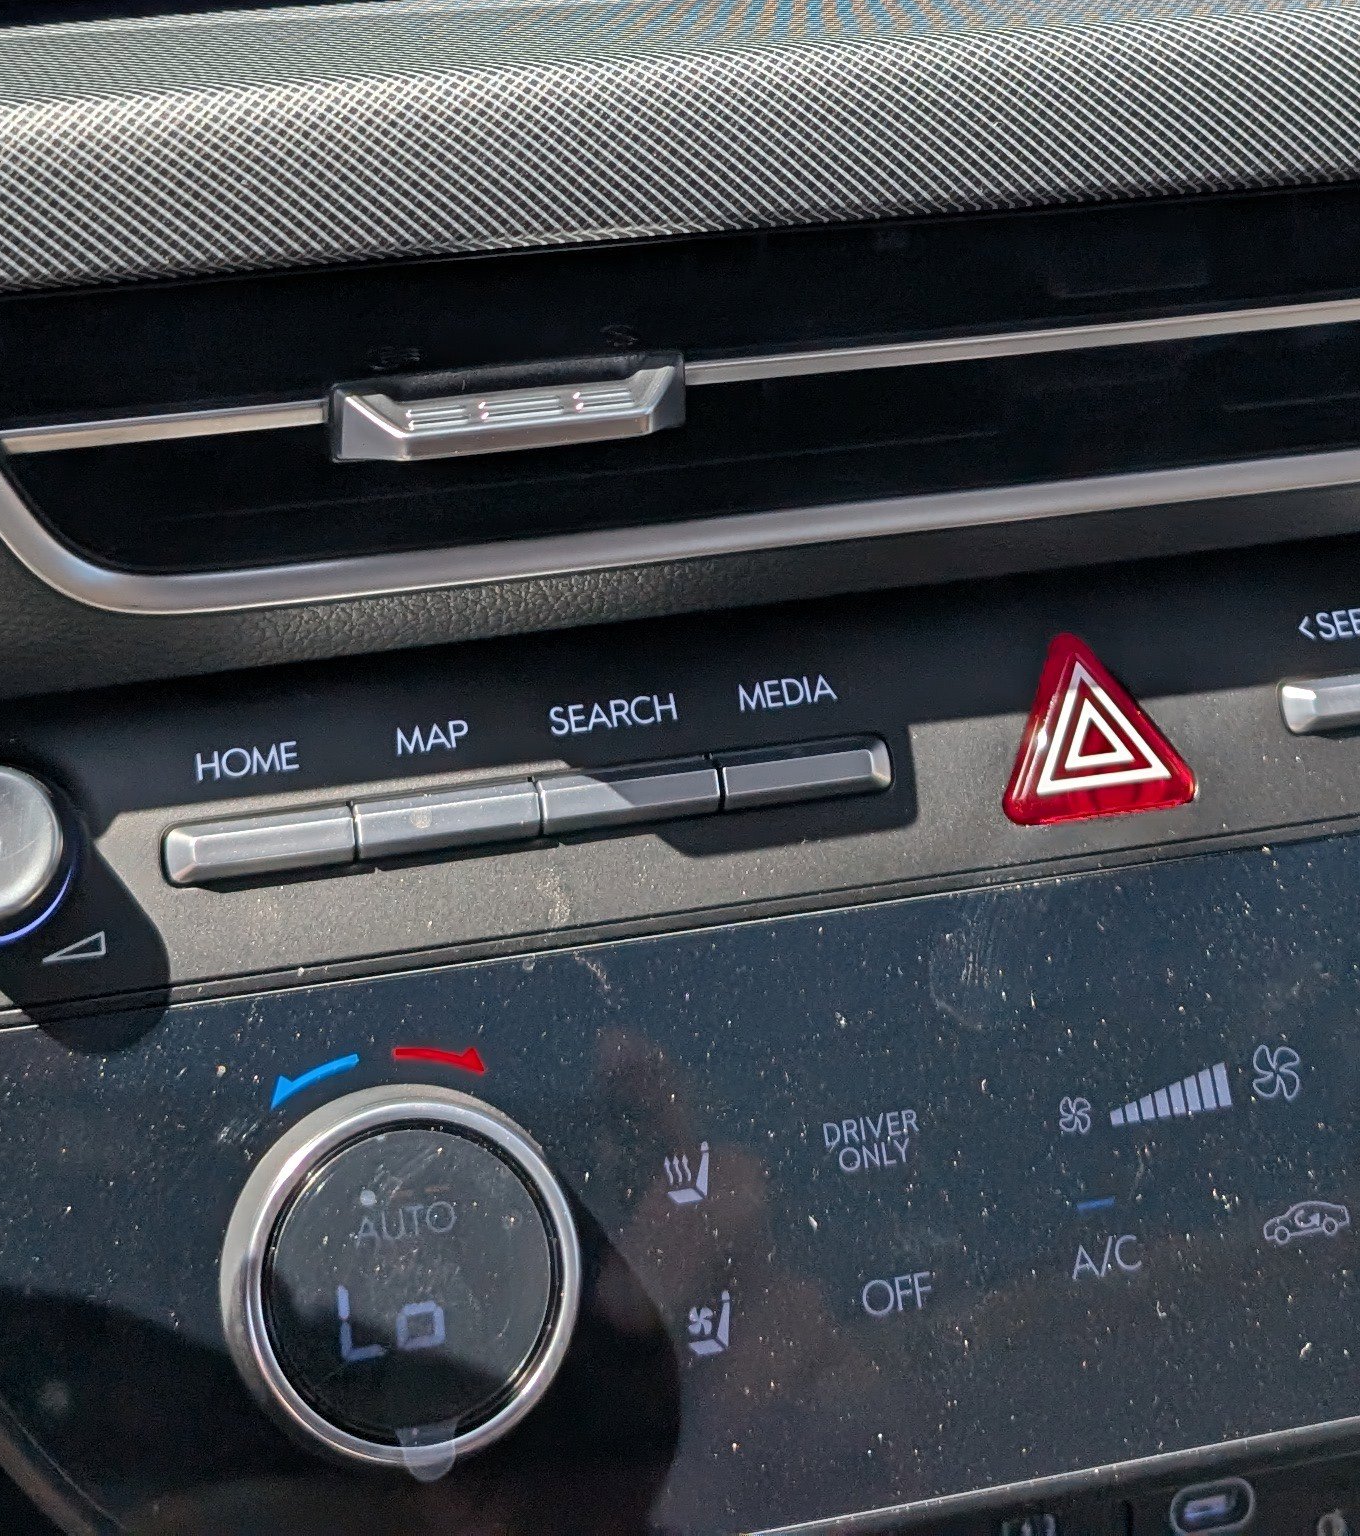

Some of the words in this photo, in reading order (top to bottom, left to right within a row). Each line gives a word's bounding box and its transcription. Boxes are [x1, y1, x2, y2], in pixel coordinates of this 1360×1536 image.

[193, 740, 301, 783] HOME
[395, 719, 470, 756] MAP
[548, 692, 678, 737] SEARCH
[737, 674, 839, 713] MEDIA
[822, 1108, 919, 1148] DRIVER
[837, 1137, 912, 1173] ONLY
[355, 1199, 458, 1245] AUTO
[1071, 1234, 1142, 1280] A/C
[861, 1270, 933, 1318] OFF
